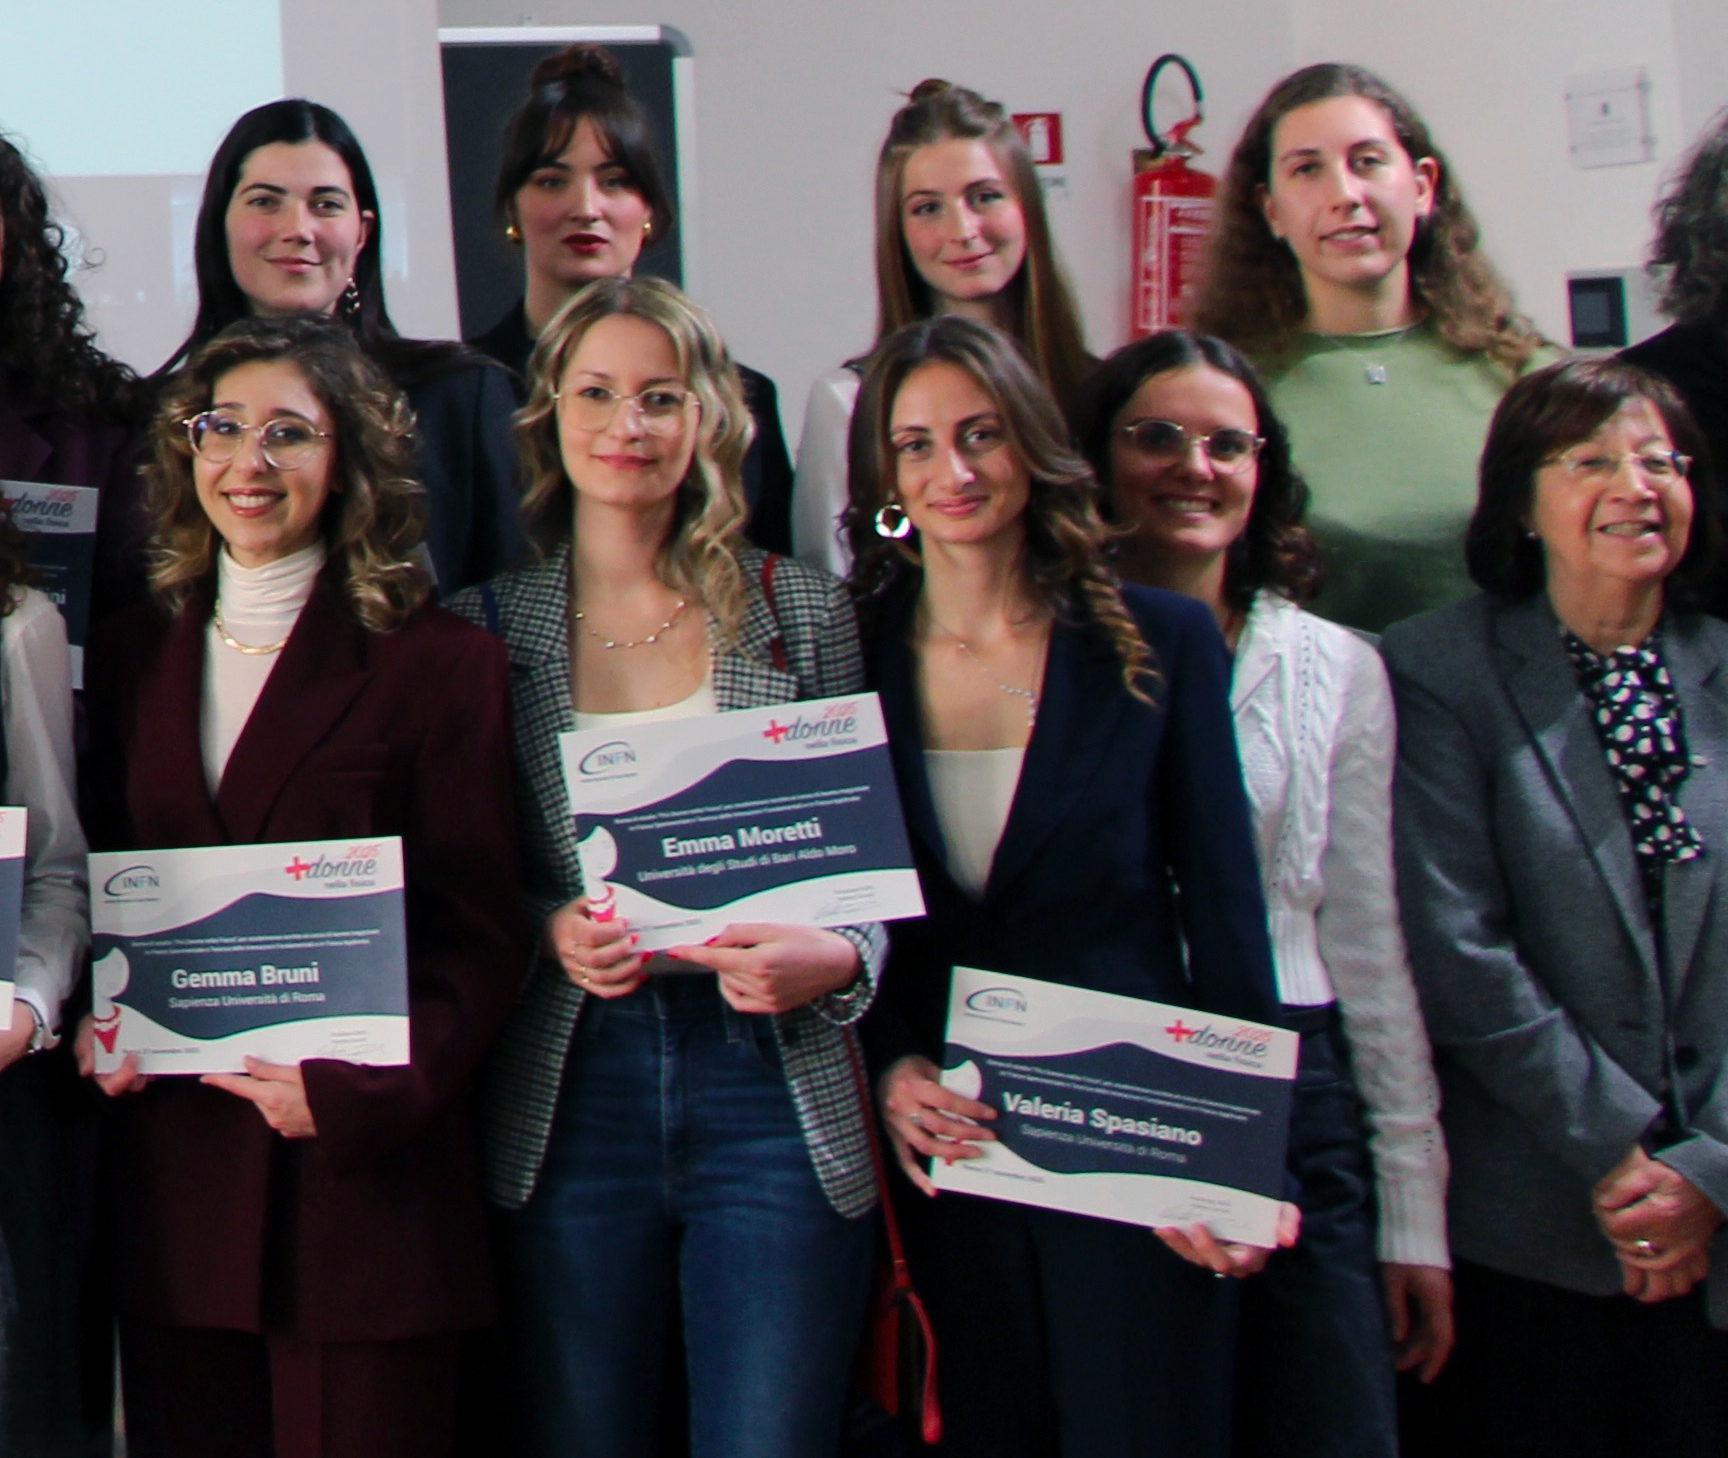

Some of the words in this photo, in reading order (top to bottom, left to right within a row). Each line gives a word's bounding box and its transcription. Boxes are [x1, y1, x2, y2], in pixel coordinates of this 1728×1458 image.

[598, 751, 636, 766] INFN
[662, 836, 735, 859] Emma
[738, 817, 822, 847] Moretti
[638, 865, 695, 882] Università
[697, 860, 725, 876] degli
[726, 857, 756, 871] Studi
[758, 854, 769, 865] di
[772, 851, 796, 864] Bari
[798, 847, 824, 860] Aldo
[826, 844, 857, 857] Moro
[123, 875, 160, 888] INFN
[171, 969, 256, 988] Gemma
[261, 962, 319, 984] Bruni
[168, 996, 220, 1010] Sapienza
[222, 994, 277, 1006] Università
[279, 992, 290, 1004] di
[293, 992, 325, 1002] Roma
[985, 995, 1028, 1013] INFN
[1003, 1092, 1085, 1125] Valeria
[1089, 1108, 1203, 1146] Spasiano
